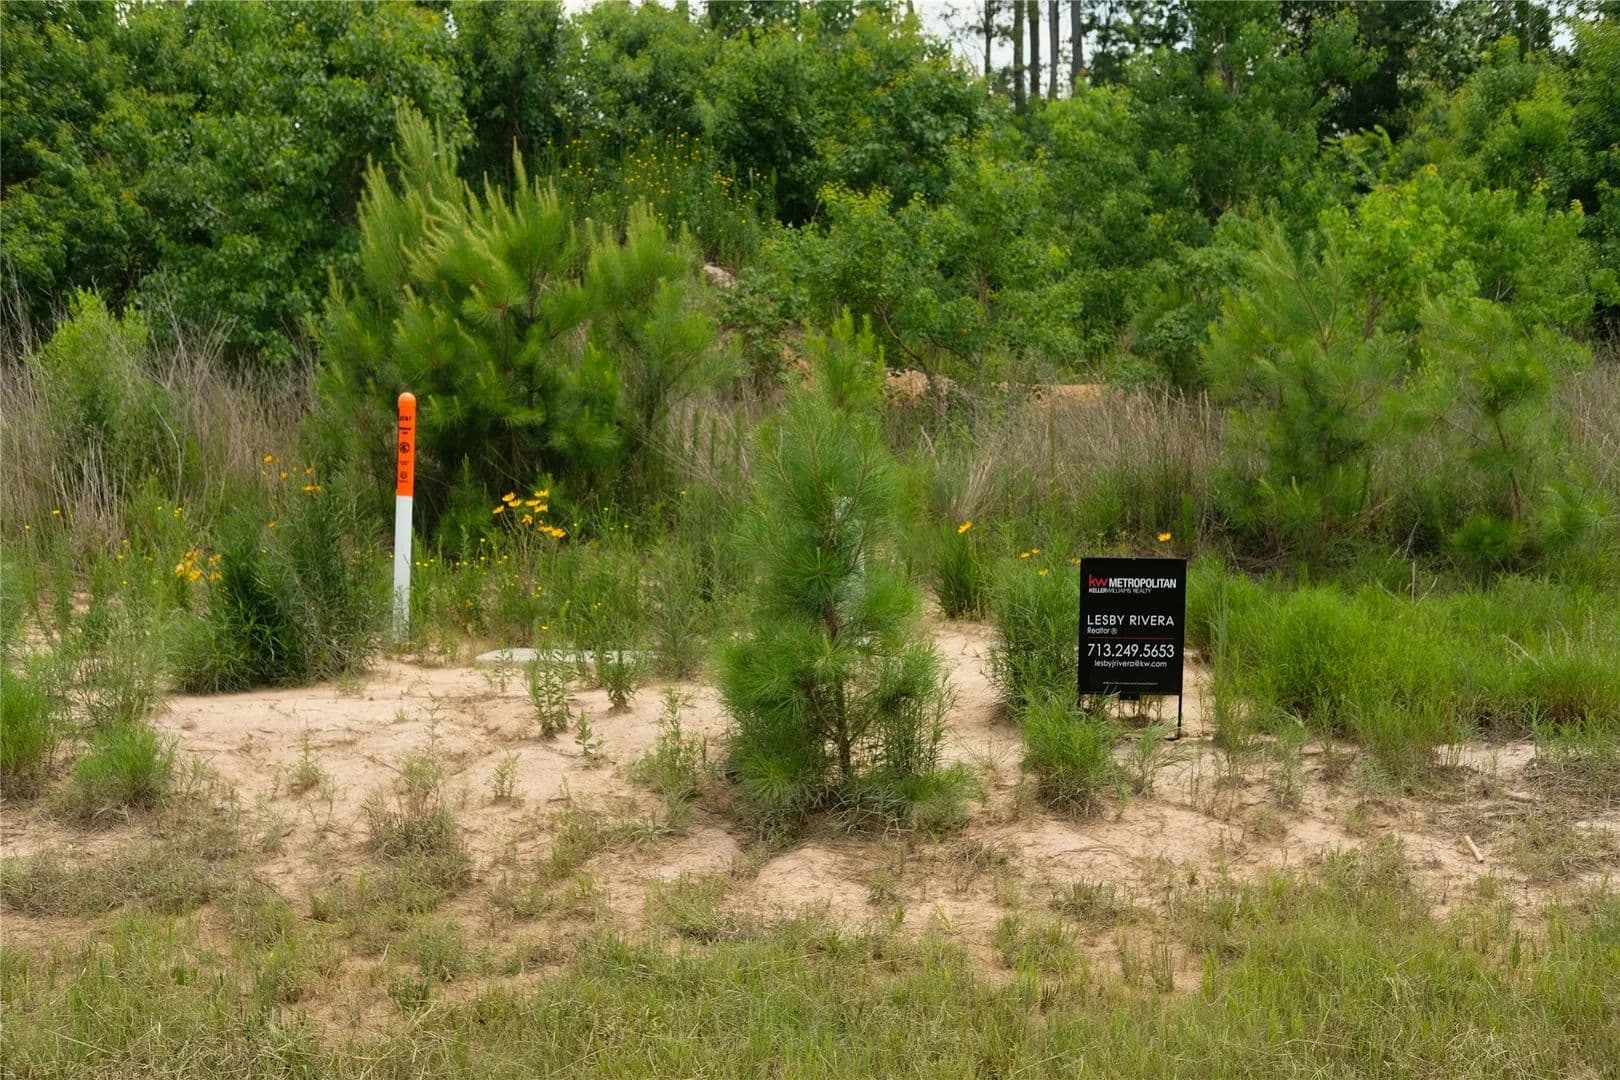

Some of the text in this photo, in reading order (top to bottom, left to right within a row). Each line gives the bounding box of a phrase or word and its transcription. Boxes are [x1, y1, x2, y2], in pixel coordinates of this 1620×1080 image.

[1088, 574, 1177, 588] kw METROPOLITAN
[1087, 614, 1175, 627] LESBY RIVERA
[1087, 627, 1110, 635] Realtor
[1087, 643, 1175, 658] 713.249.5653
[1094, 660, 1167, 668] lesbyjrivera@kw.com
